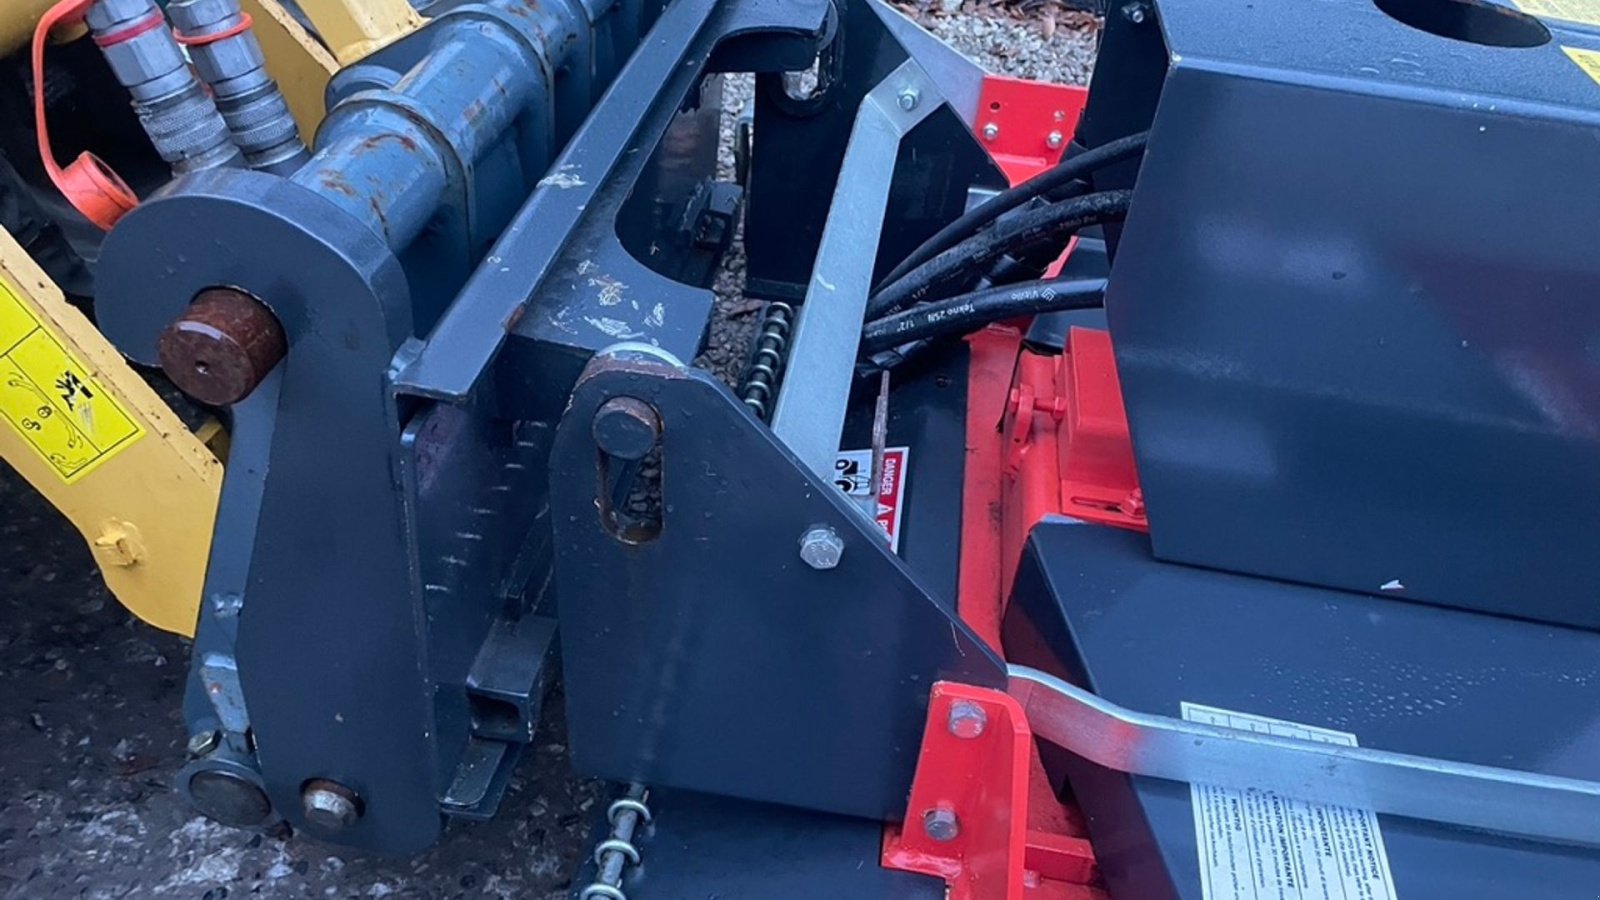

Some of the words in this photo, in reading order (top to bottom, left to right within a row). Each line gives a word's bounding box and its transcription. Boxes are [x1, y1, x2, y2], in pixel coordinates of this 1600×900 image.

[947, 302, 976, 317] Tekno
[881, 458, 896, 495] DANGER
[1315, 807, 1333, 857] IMPORTANTE
[1279, 835, 1295, 888] IMPORTANTE
[1366, 849, 1381, 880] NOTICE
